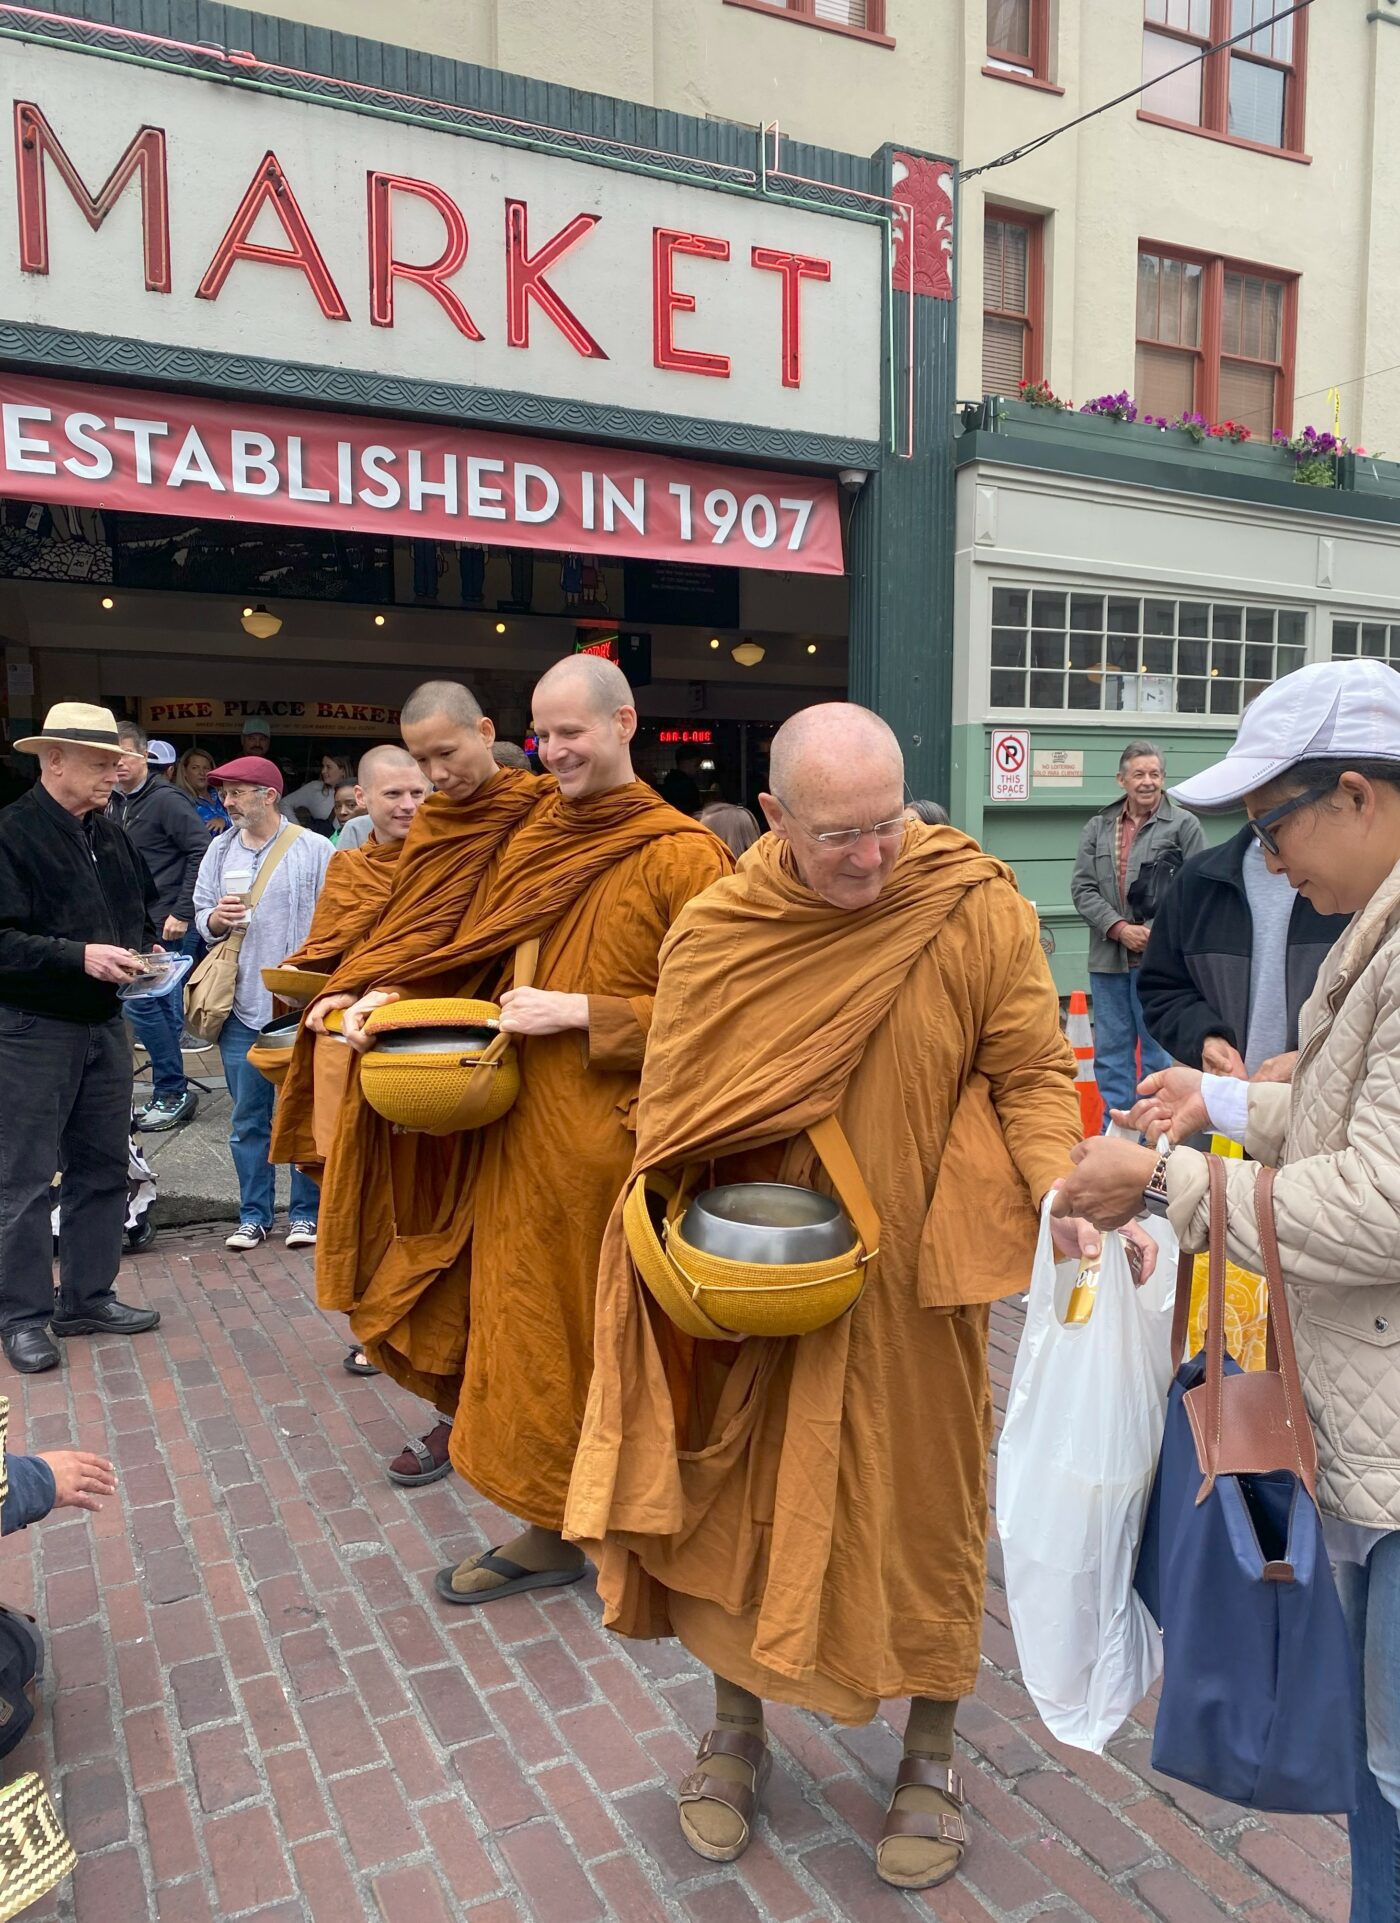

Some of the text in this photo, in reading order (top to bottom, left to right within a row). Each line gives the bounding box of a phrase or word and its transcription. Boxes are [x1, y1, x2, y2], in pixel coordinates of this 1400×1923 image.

[13, 99, 832, 388] MARKET
[2, 403, 814, 551] ESTABLISHED IN 1907
[150, 703, 212, 721] PIKE
[224, 701, 305, 716] PLACE
[997, 784, 1024, 794] SPACE
[1001, 774, 1021, 784] THIS
